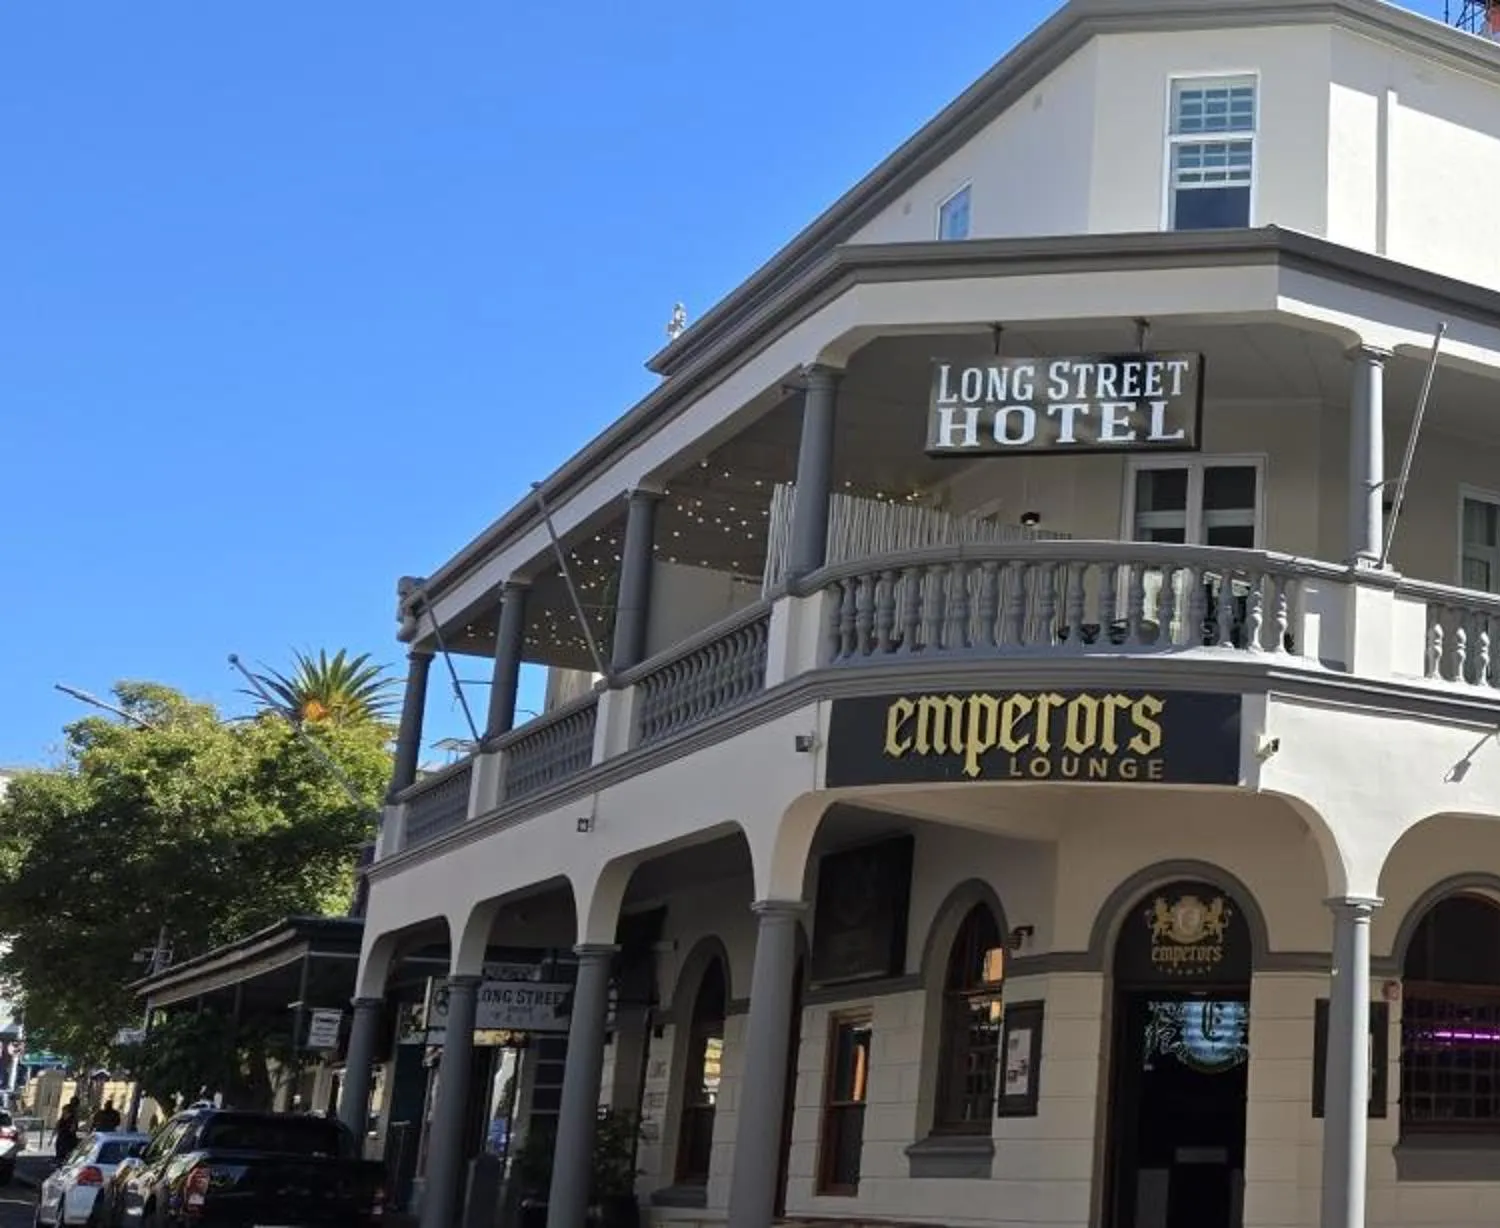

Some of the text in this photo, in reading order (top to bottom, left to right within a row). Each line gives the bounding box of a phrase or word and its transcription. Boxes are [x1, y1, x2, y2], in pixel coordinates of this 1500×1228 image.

[935, 400, 1186, 448] HOTEL
[884, 692, 1167, 777] emperors
[1009, 756, 1165, 779] LOUNGE
[478, 988, 566, 1005] ONG STREE
